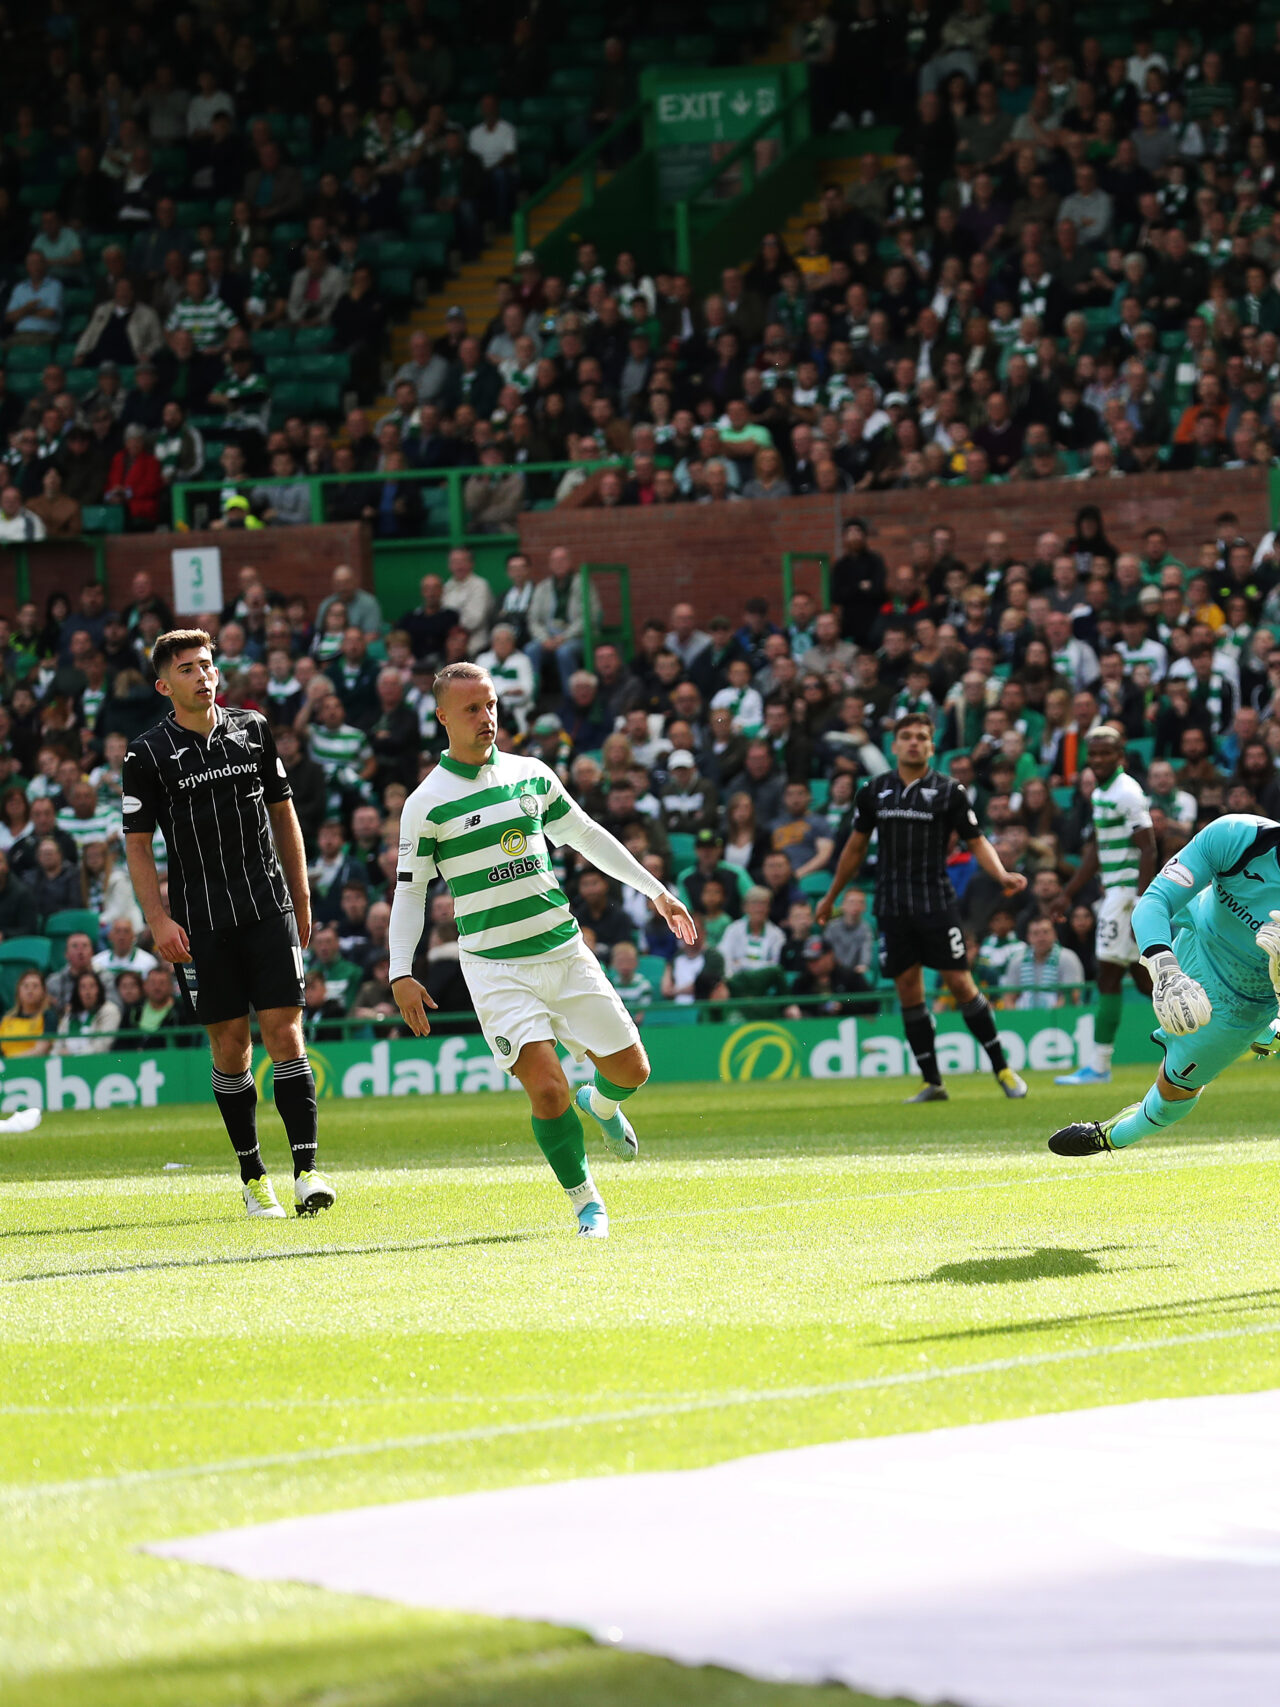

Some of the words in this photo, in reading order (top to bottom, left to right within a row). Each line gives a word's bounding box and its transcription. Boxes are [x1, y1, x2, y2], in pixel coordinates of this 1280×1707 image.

[659, 91, 723, 123] EXIT
[190, 556, 203, 588] 3
[178, 762, 258, 790] srjwindows
[1215, 883, 1265, 931] srjwind
[948, 926, 965, 959] 2
[1098, 920, 1118, 940] 23
[0, 1055, 165, 1113] abet
